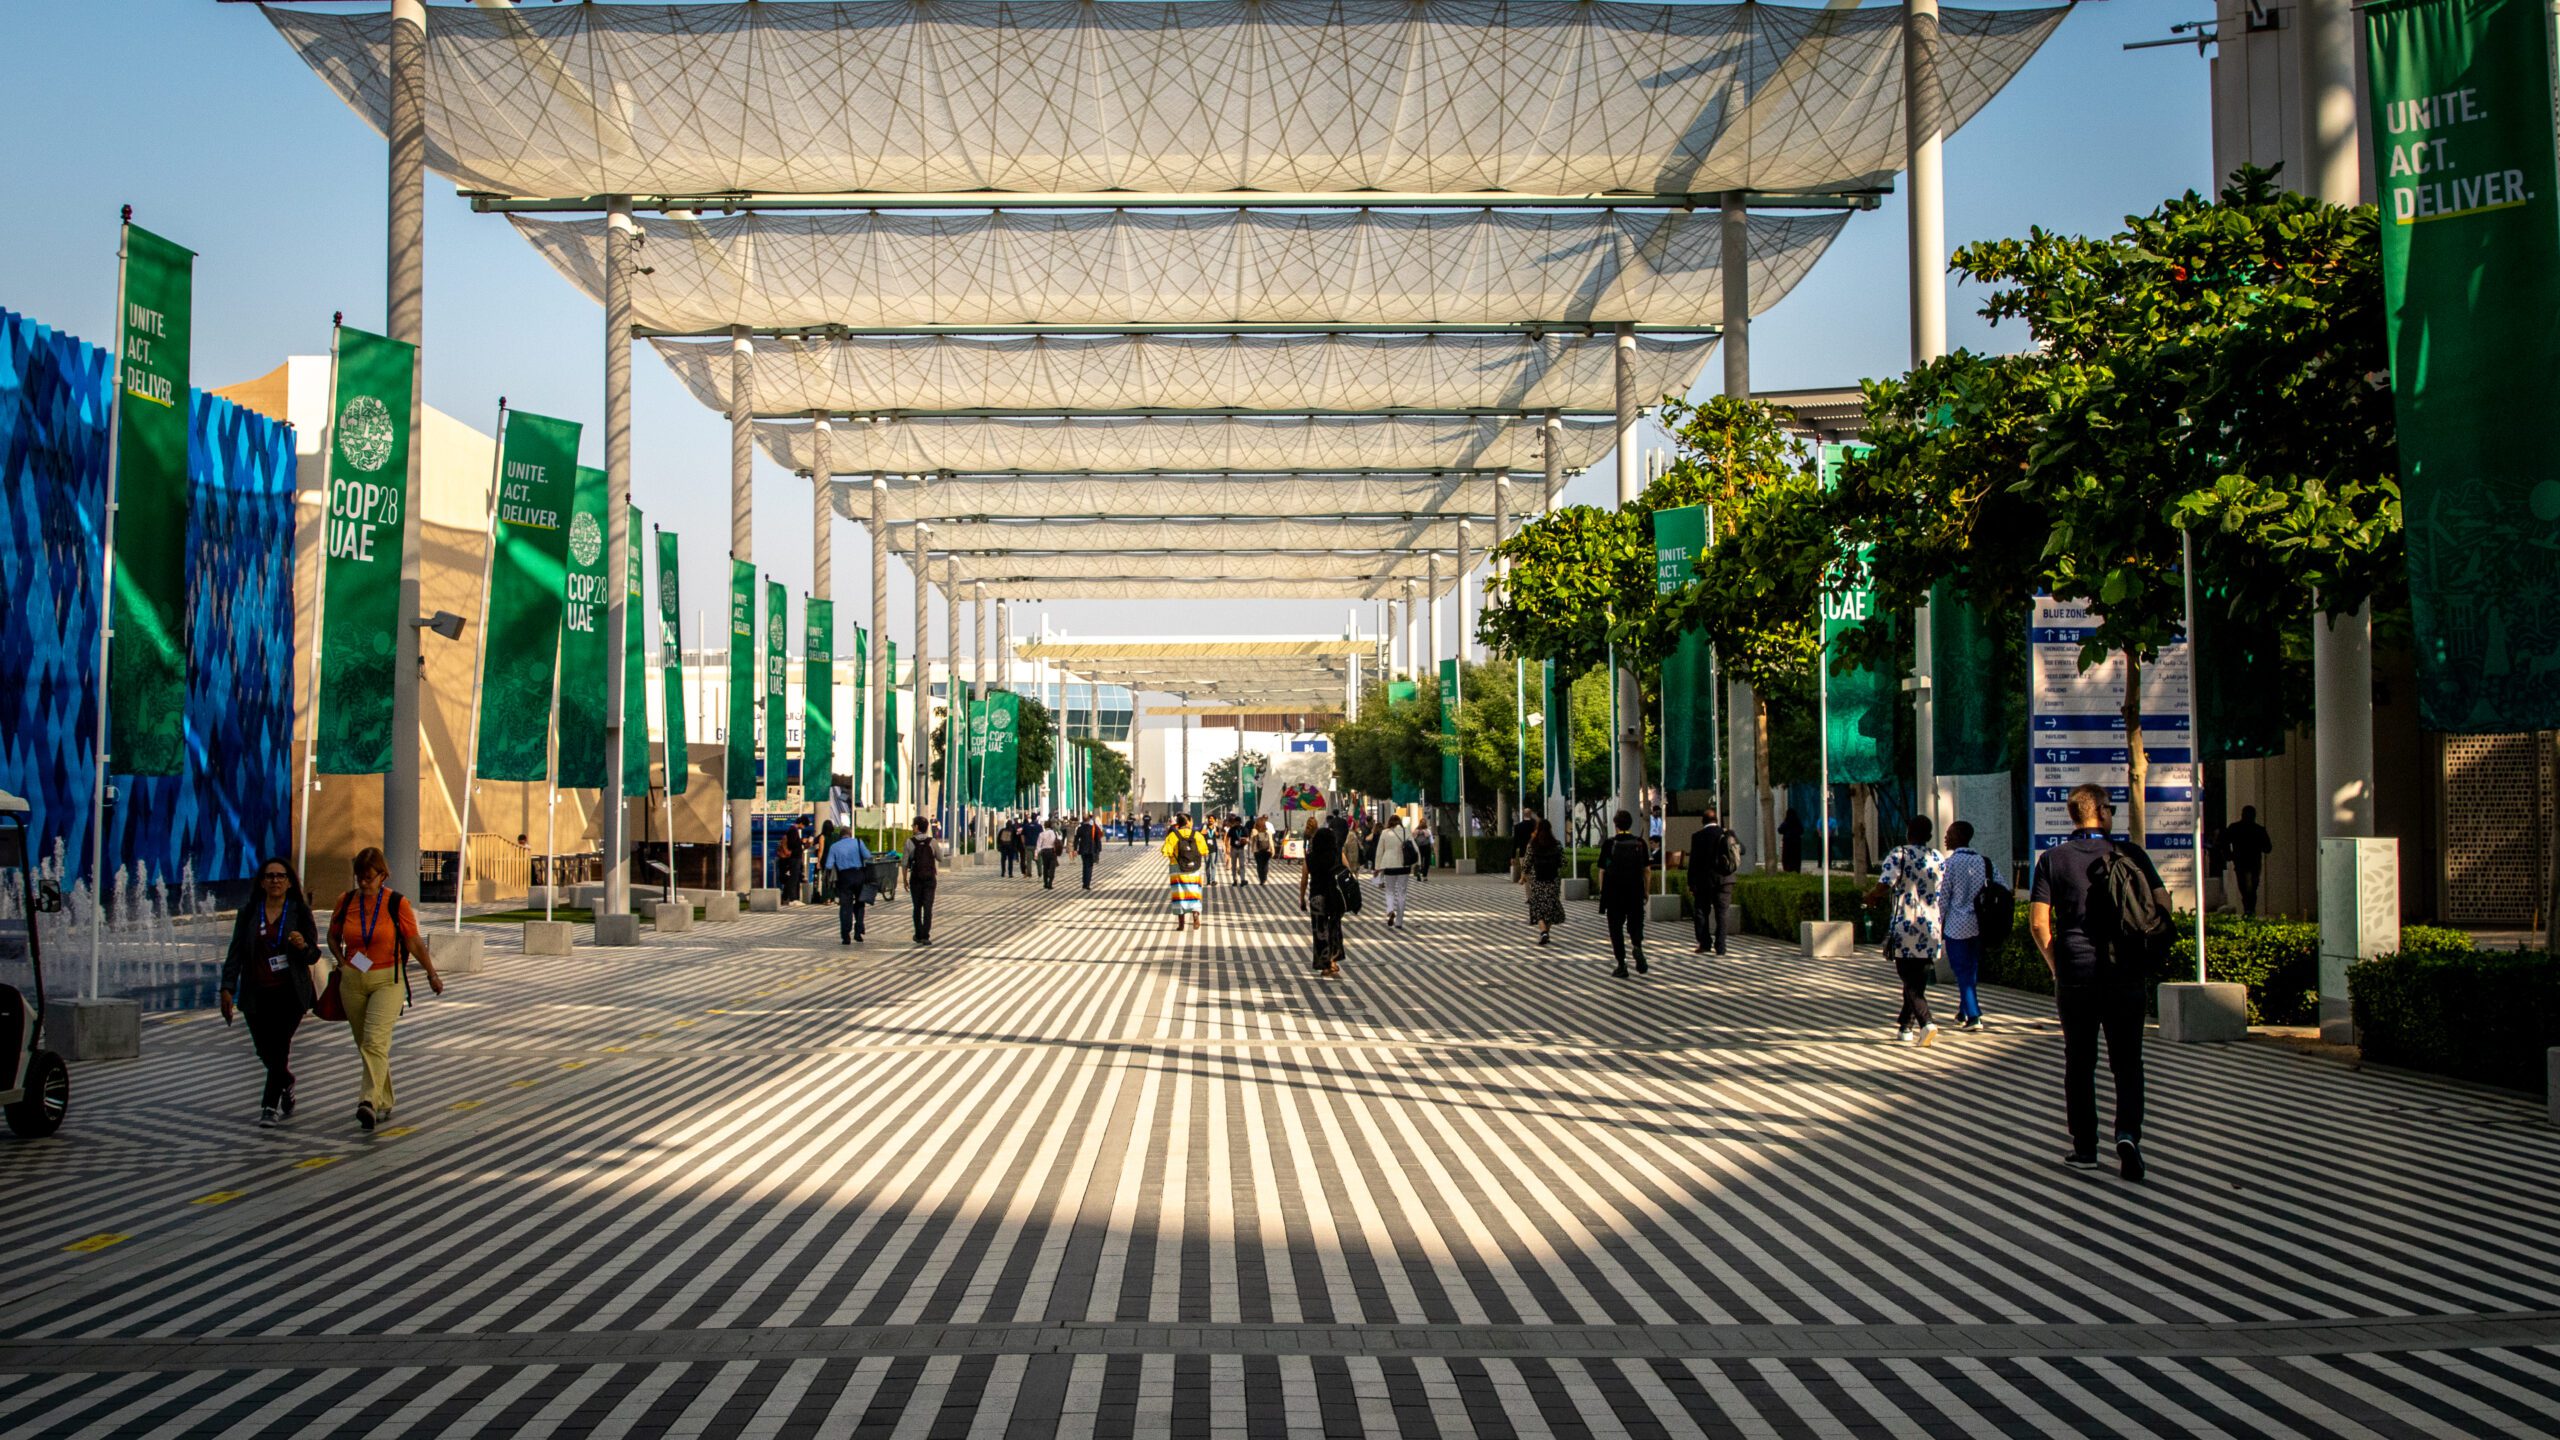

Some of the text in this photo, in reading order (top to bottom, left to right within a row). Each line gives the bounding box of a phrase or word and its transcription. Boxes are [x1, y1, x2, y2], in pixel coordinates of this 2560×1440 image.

[2386, 88, 2488, 134] UNITE.
[2389, 137, 2456, 178] ACT.
[2393, 168, 2536, 221] DELIVER.
[128, 301, 167, 339] UNITE.
[127, 335, 153, 366] ACT.
[127, 365, 175, 406] DELIVER.
[507, 460, 549, 484] UNITE.
[332, 478, 399, 525] COP28
[504, 482, 531, 503] ACT.
[502, 503, 560, 529] DELIVER.
[329, 518, 377, 562] UAE
[1659, 564, 1681, 578] ACT.
[567, 572, 609, 604] COP28
[567, 602, 594, 633] UAE
[1828, 590, 1867, 621] UAE
[2042, 608, 2087, 619] BLUE ZONE
[770, 675, 784, 695] UAE
[988, 741, 1004, 752] UAE
